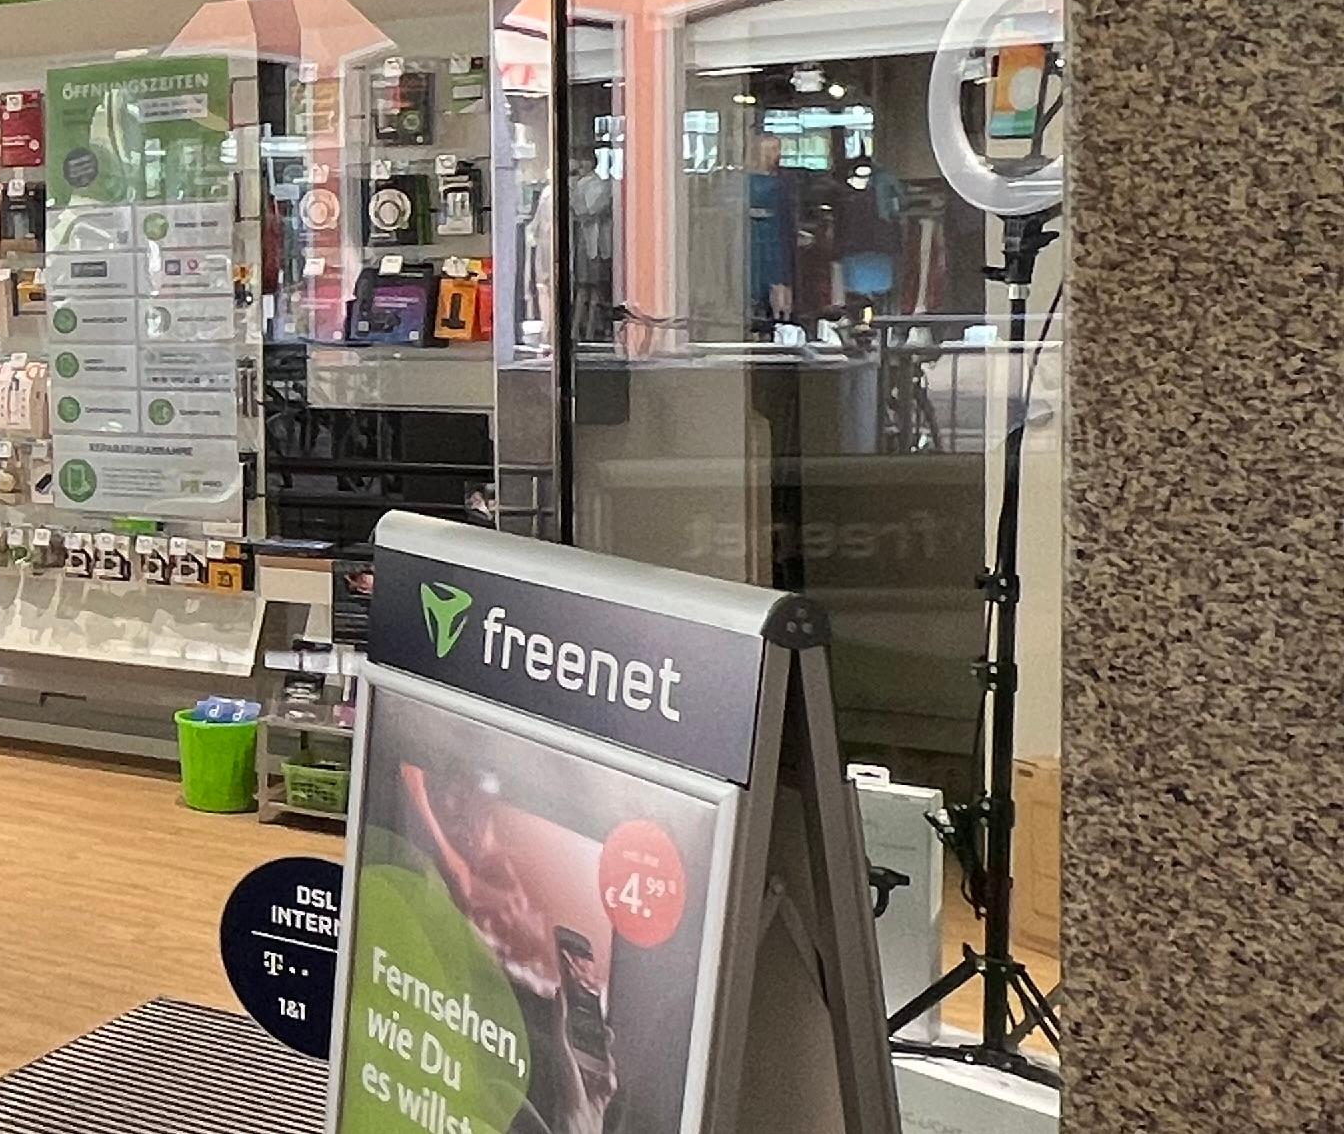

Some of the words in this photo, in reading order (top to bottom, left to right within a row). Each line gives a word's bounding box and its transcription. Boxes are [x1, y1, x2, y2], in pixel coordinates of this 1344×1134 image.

[483, 606, 681, 722] freenet
[297, 885, 338, 912] DSL
[278, 997, 306, 1021] 1&1
[373, 946, 525, 1078] Fernsehen,
[367, 1007, 414, 1060] wie
[420, 1031, 461, 1092] Du
[362, 1062, 391, 1102] es
